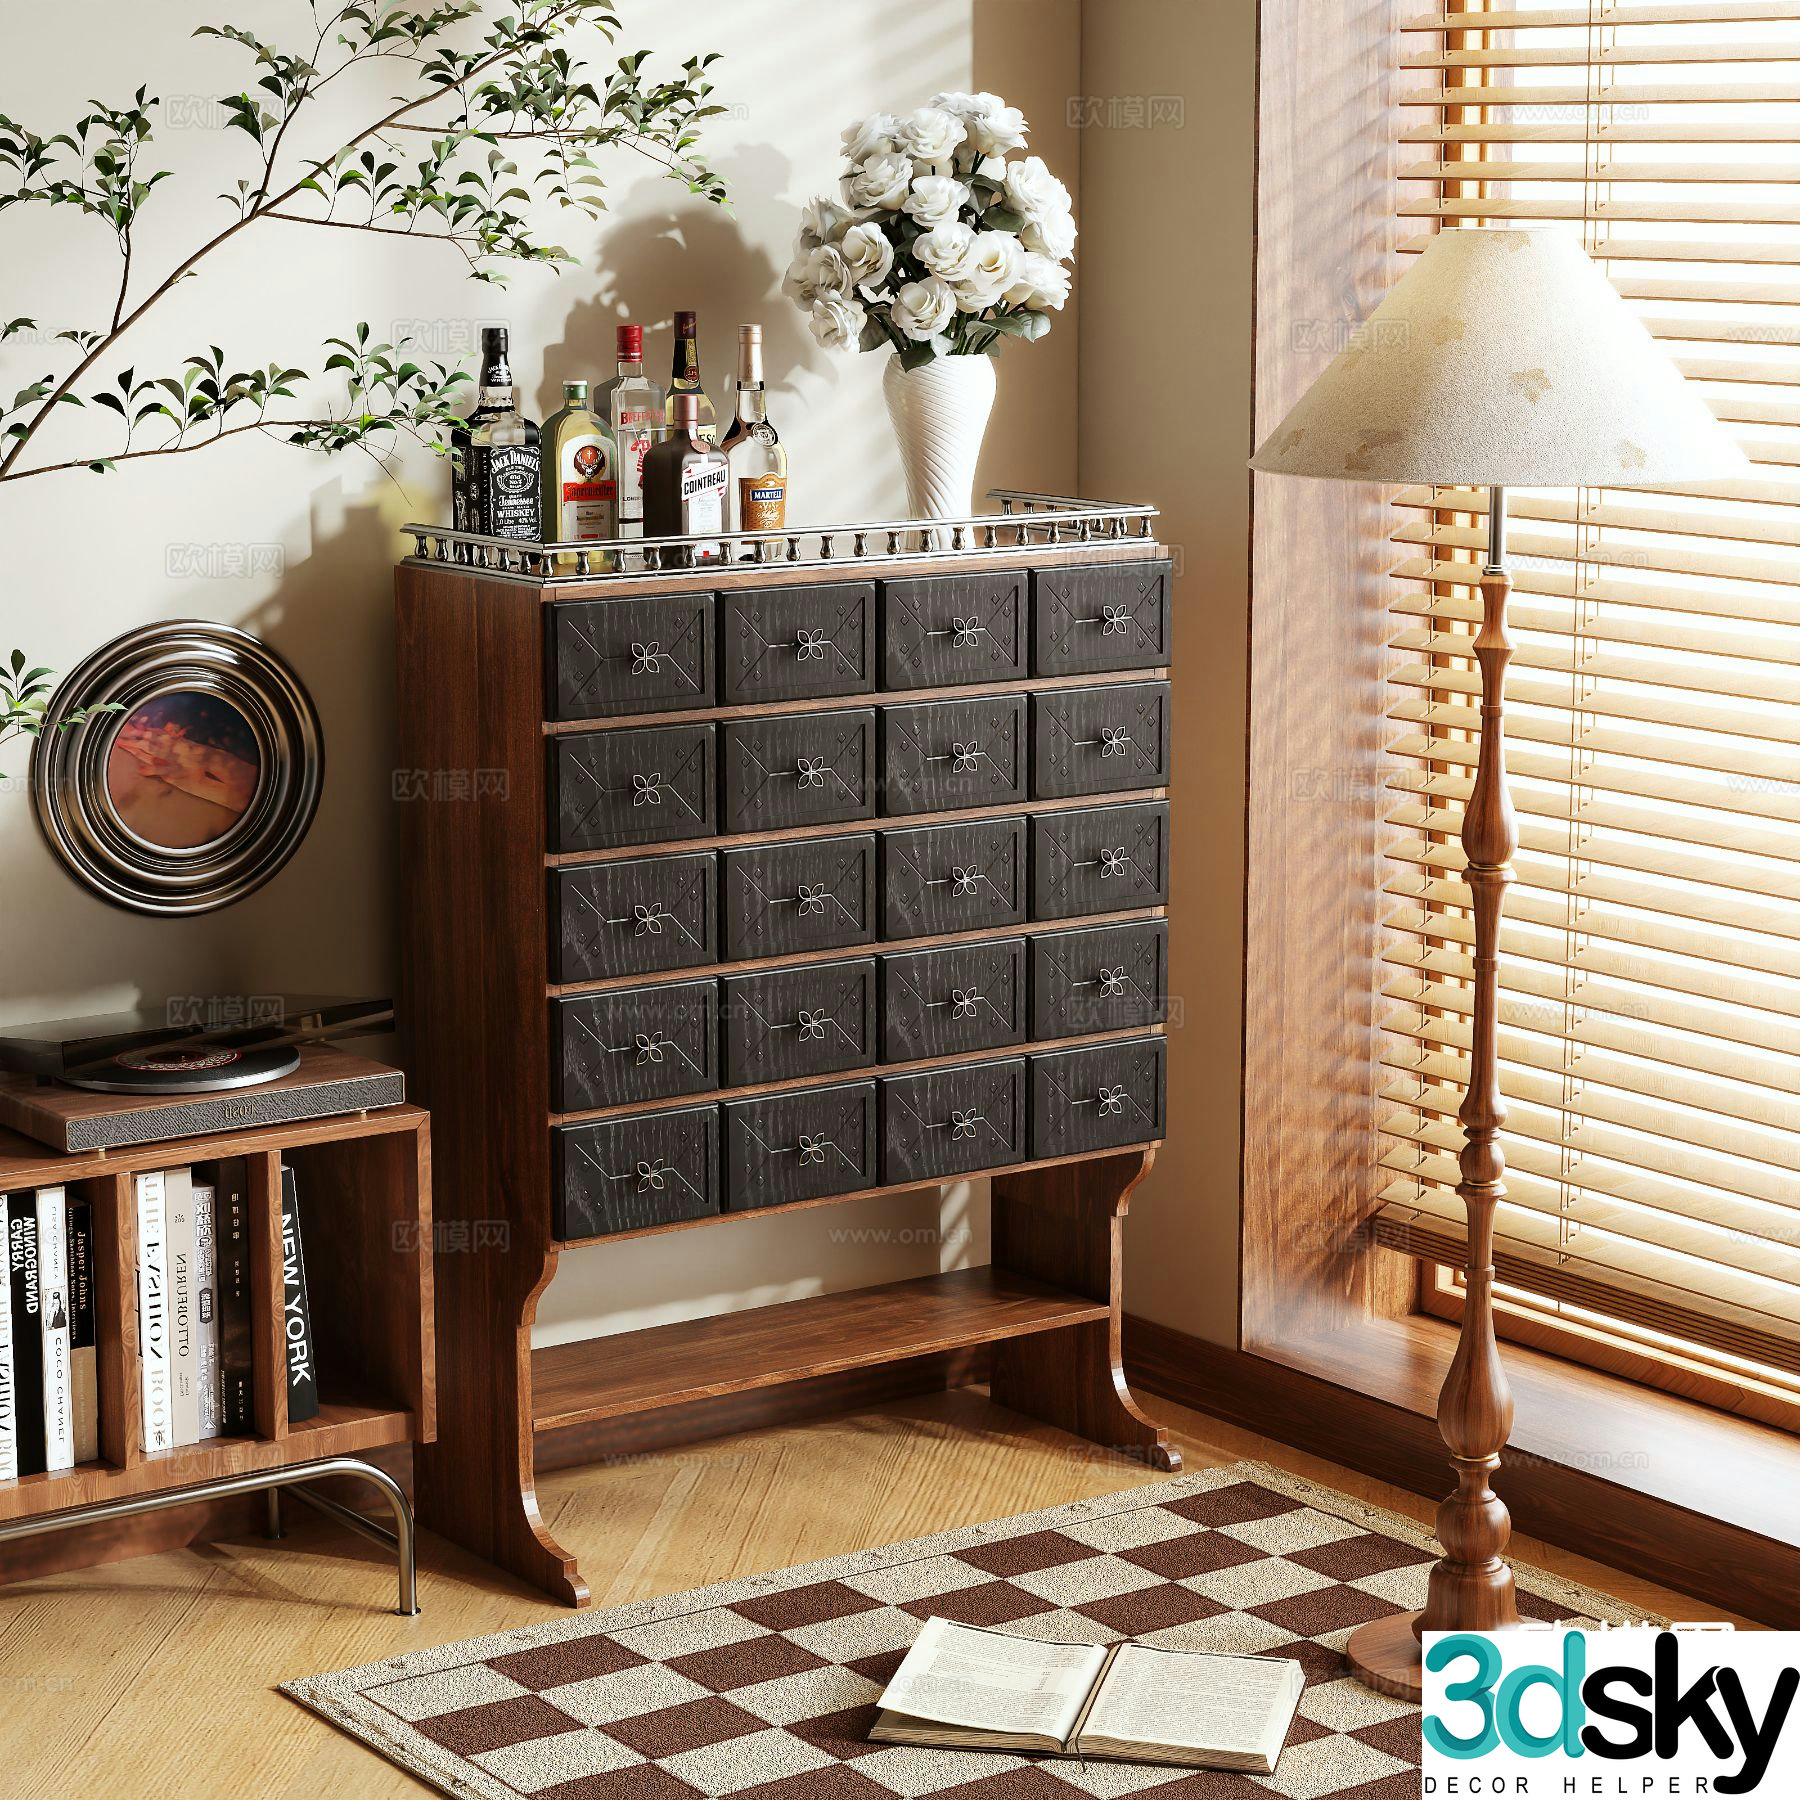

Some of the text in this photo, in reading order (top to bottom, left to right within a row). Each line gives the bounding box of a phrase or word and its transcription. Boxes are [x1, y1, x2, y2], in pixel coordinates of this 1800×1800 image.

[490, 455, 510, 474] JACK
[683, 469, 726, 496] COINTREAU
[753, 490, 782, 500] MARTELL
[497, 508, 535, 518] WHISKEY
[77, 1231, 88, 1310] Jasper Johns
[282, 1213, 312, 1387] NEW YORK
